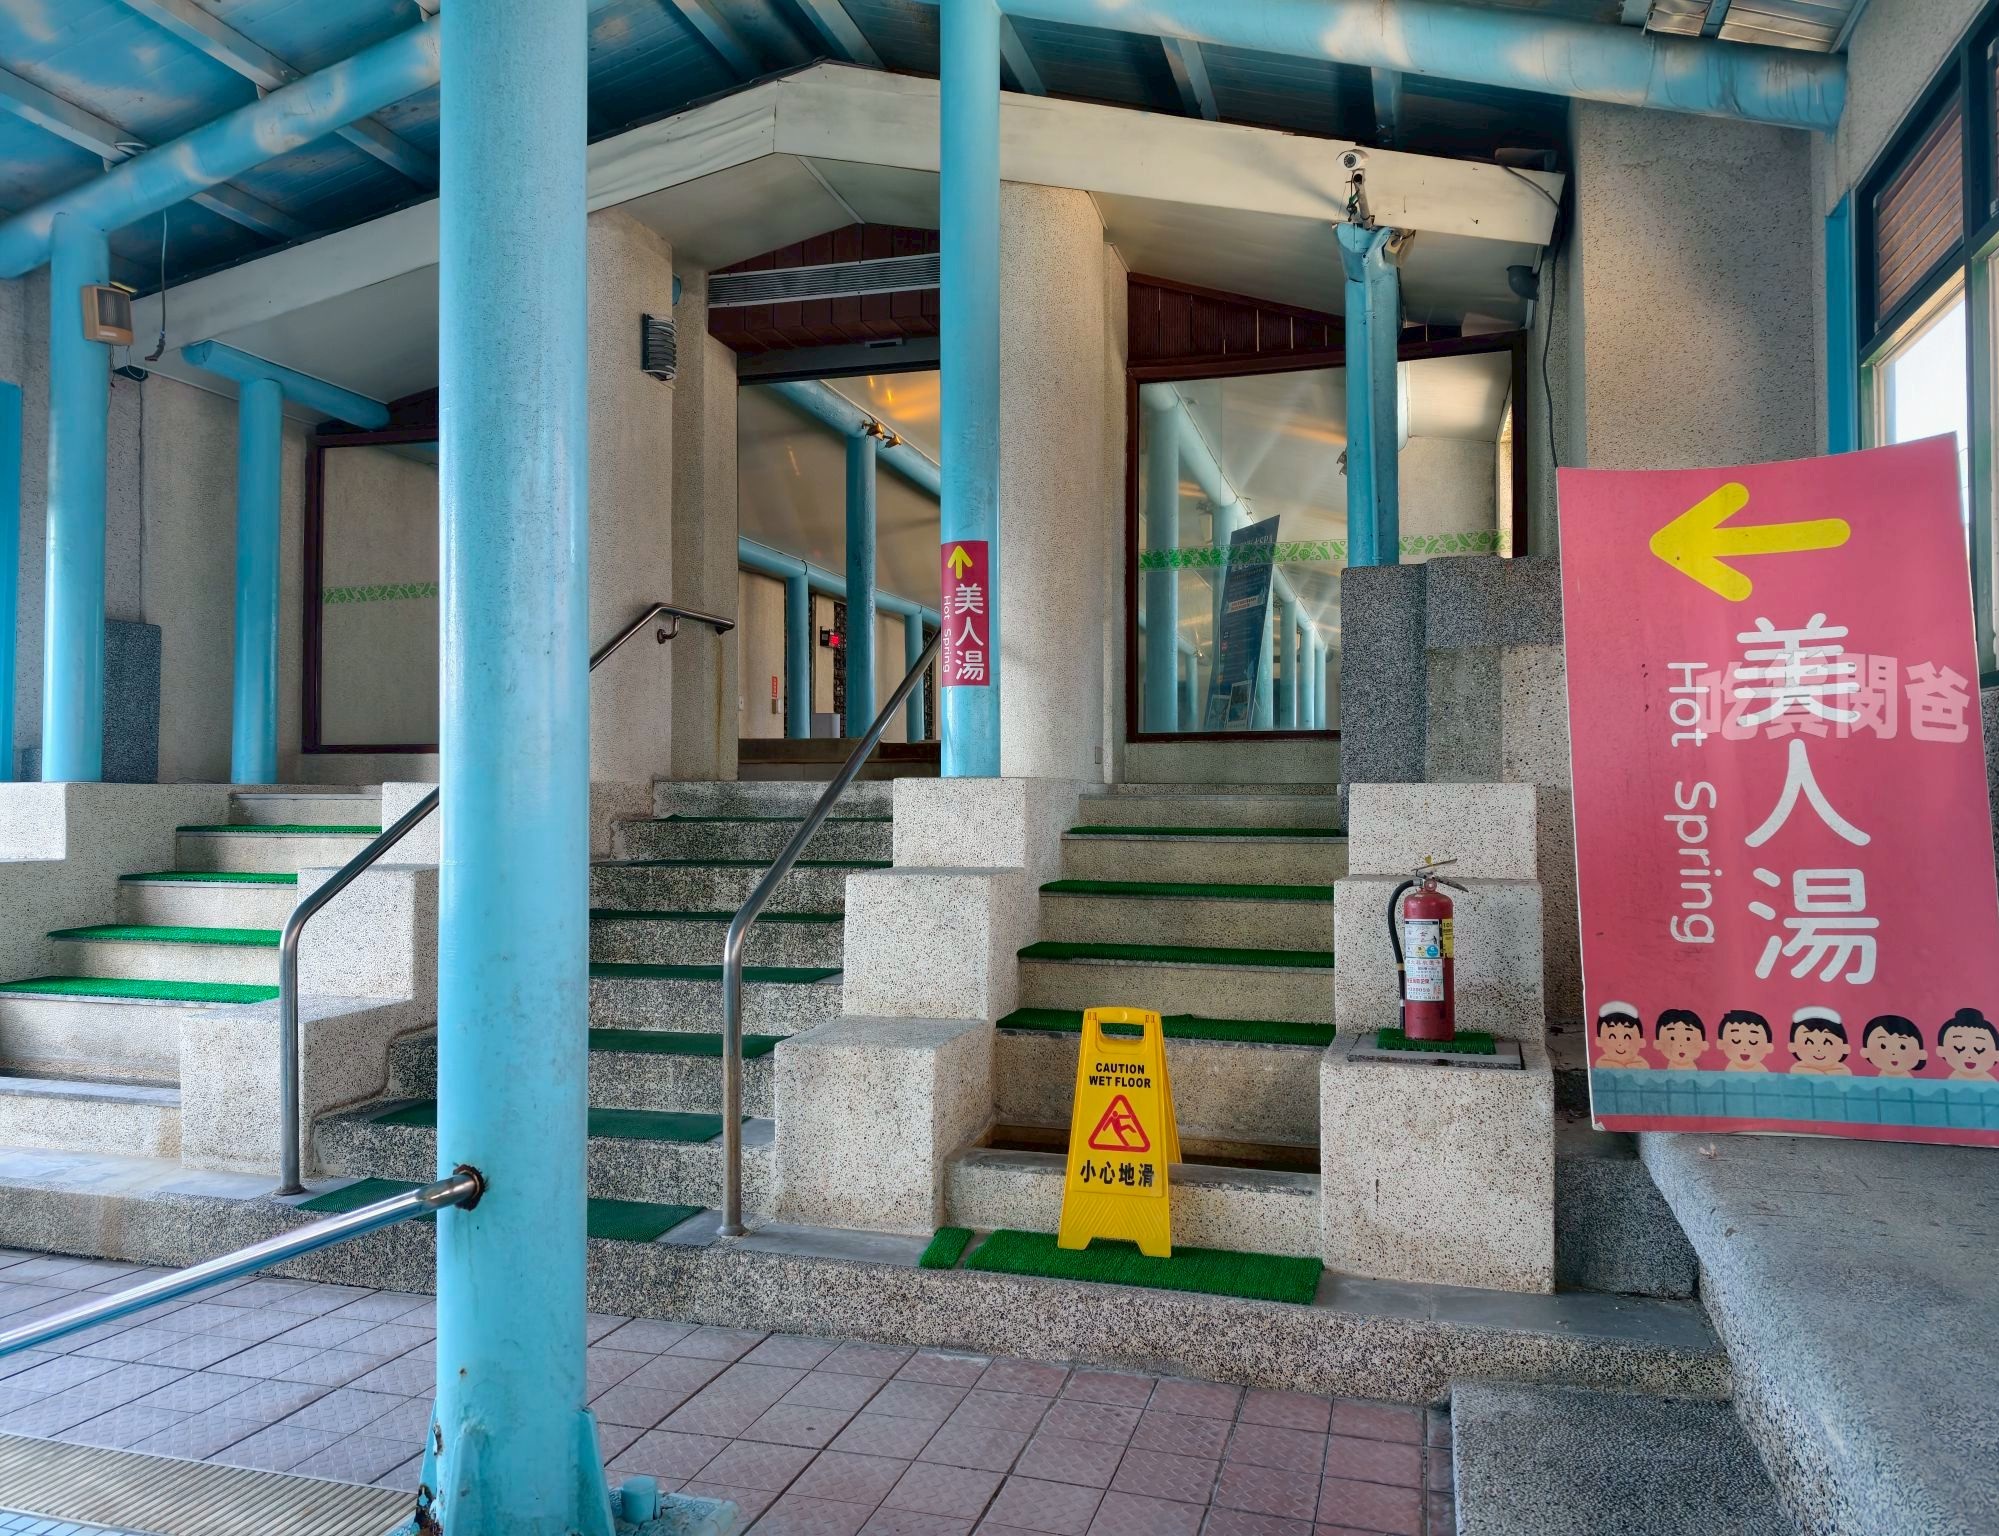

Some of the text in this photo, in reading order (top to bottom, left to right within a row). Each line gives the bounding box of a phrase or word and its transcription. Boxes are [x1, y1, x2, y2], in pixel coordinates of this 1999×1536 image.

[942, 595, 952, 673] Hot Spring
[954, 583, 985, 681] 美人湯
[1663, 662, 1723, 945] Hot Spring
[1733, 613, 1880, 985] 美人湯
[1088, 1075, 1152, 1089] WET FLOOR
[1095, 1062, 1145, 1075] CAUTION
[1080, 1159, 1155, 1188] 小心地滑
